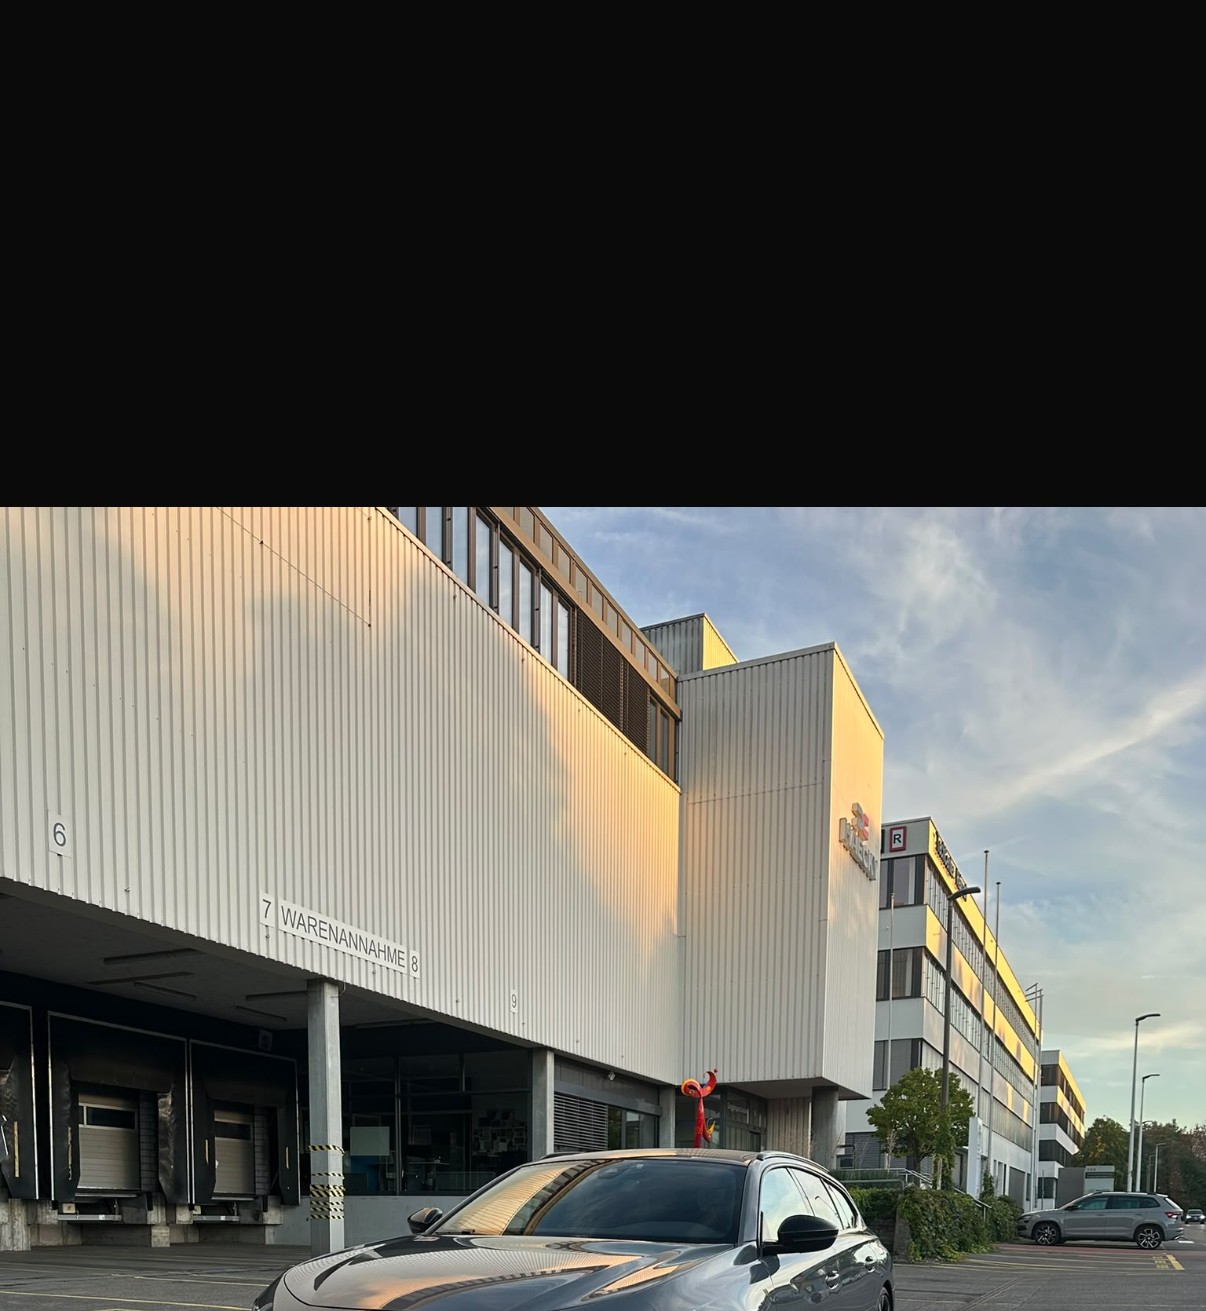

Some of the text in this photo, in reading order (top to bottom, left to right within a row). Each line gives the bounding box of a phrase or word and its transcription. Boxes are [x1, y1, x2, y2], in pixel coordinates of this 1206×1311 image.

[53, 822, 66, 846] 6
[893, 833, 902, 845] R
[262, 899, 418, 972] 7 WARENANNAHME 8
[511, 993, 517, 1008] 9
